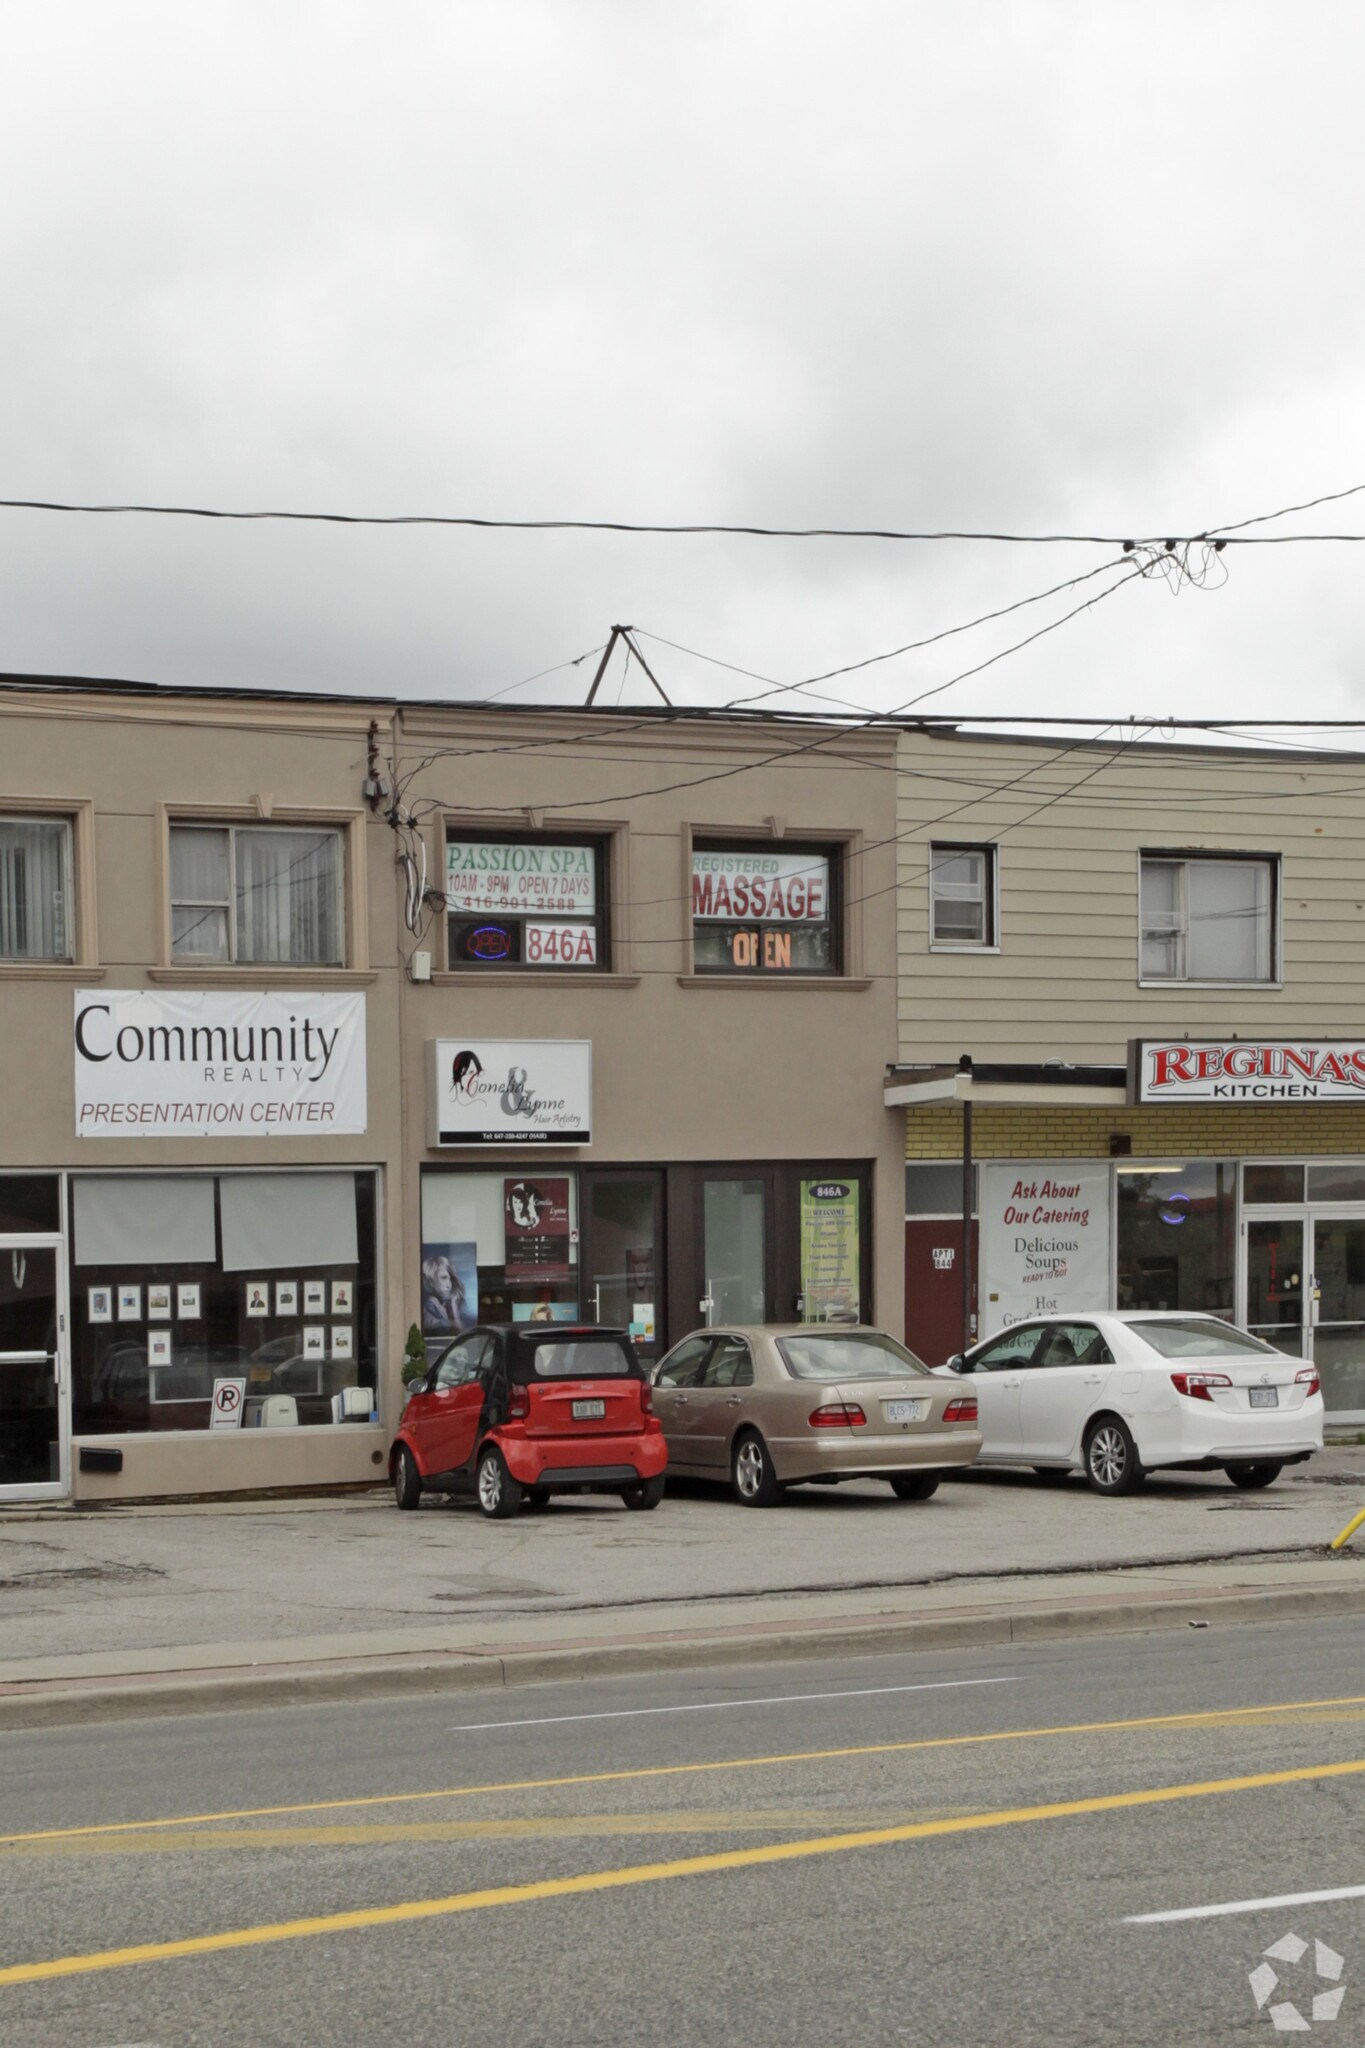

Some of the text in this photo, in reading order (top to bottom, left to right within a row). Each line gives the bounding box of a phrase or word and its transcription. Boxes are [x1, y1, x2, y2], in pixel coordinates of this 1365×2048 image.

[447, 847, 590, 874] PASSION SPA
[693, 856, 779, 873] REGISTERED
[449, 873, 477, 894] 10AM
[487, 875, 509, 893] 9PM
[518, 876, 549, 895] OPEN
[552, 876, 559, 895] 7
[561, 877, 590, 896] DAYS
[693, 873, 823, 919] MASSAGE
[467, 932, 512, 952] OPEN
[528, 928, 594, 962] 846A
[733, 932, 791, 968] OPEN
[75, 1005, 340, 1082] Community
[204, 1067, 303, 1082] REALTY
[1214, 1084, 1318, 1097] KITCHEN
[80, 1102, 335, 1123] PRESENTATION CENTER
[515, 1095, 565, 1119] Lynne
[817, 1187, 842, 1197] 846A
[1011, 1180, 1081, 1199] Ask About
[1003, 1206, 1089, 1227] Our Catering
[1014, 1237, 1079, 1253] Delicious
[1025, 1254, 1067, 1271] Soups
[1022, 1275, 1044, 1284] READY
[1045, 1271, 1054, 1279] TO
[1035, 1296, 1058, 1310] Hot
